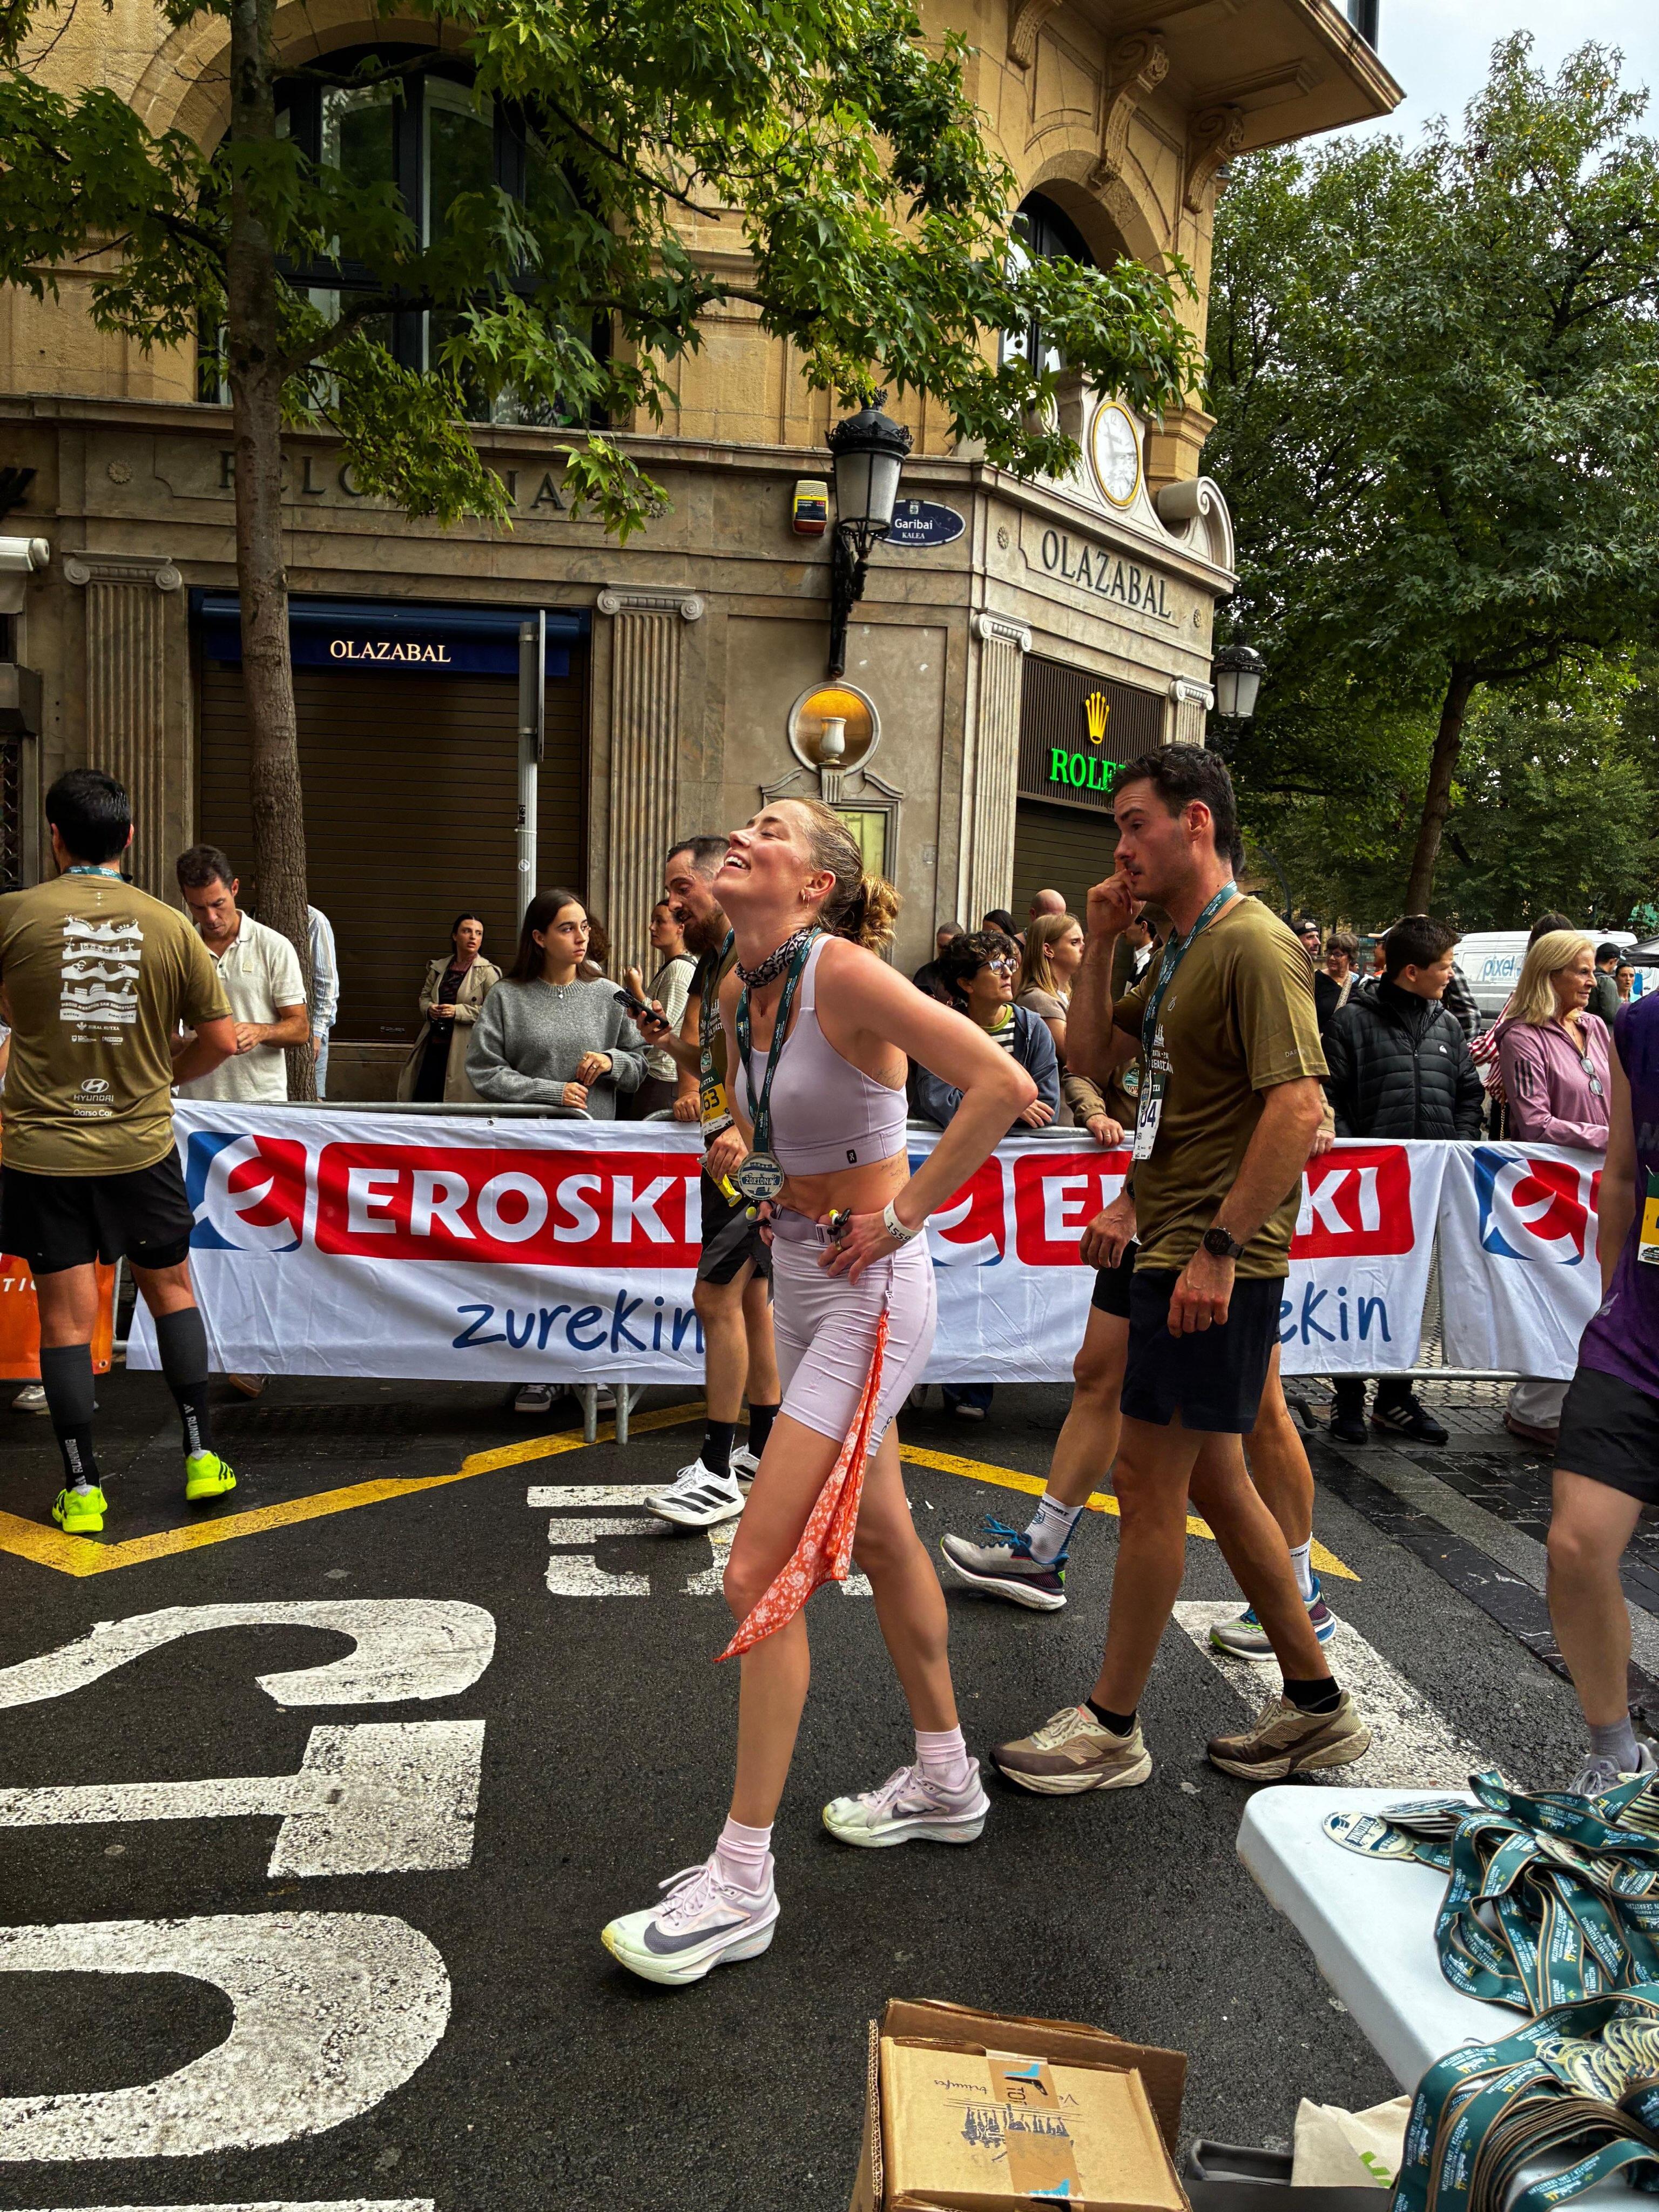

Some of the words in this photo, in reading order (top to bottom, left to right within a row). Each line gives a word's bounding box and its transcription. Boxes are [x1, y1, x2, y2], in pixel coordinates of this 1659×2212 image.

[894, 518, 933, 530] Garibai
[1042, 529, 1171, 618] OLAZABAL
[329, 639, 451, 663] OLAZABAL
[1049, 748, 1126, 793] ROLE
[1483, 955, 1515, 982] pixel
[701, 1088, 720, 1111] 63
[348, 1168, 702, 1244] EROSKI
[887, 1222, 912, 1242] 1559
[65, 1439, 83, 1474] RUNNING
[1506, 1993, 1527, 2004] DONOST
